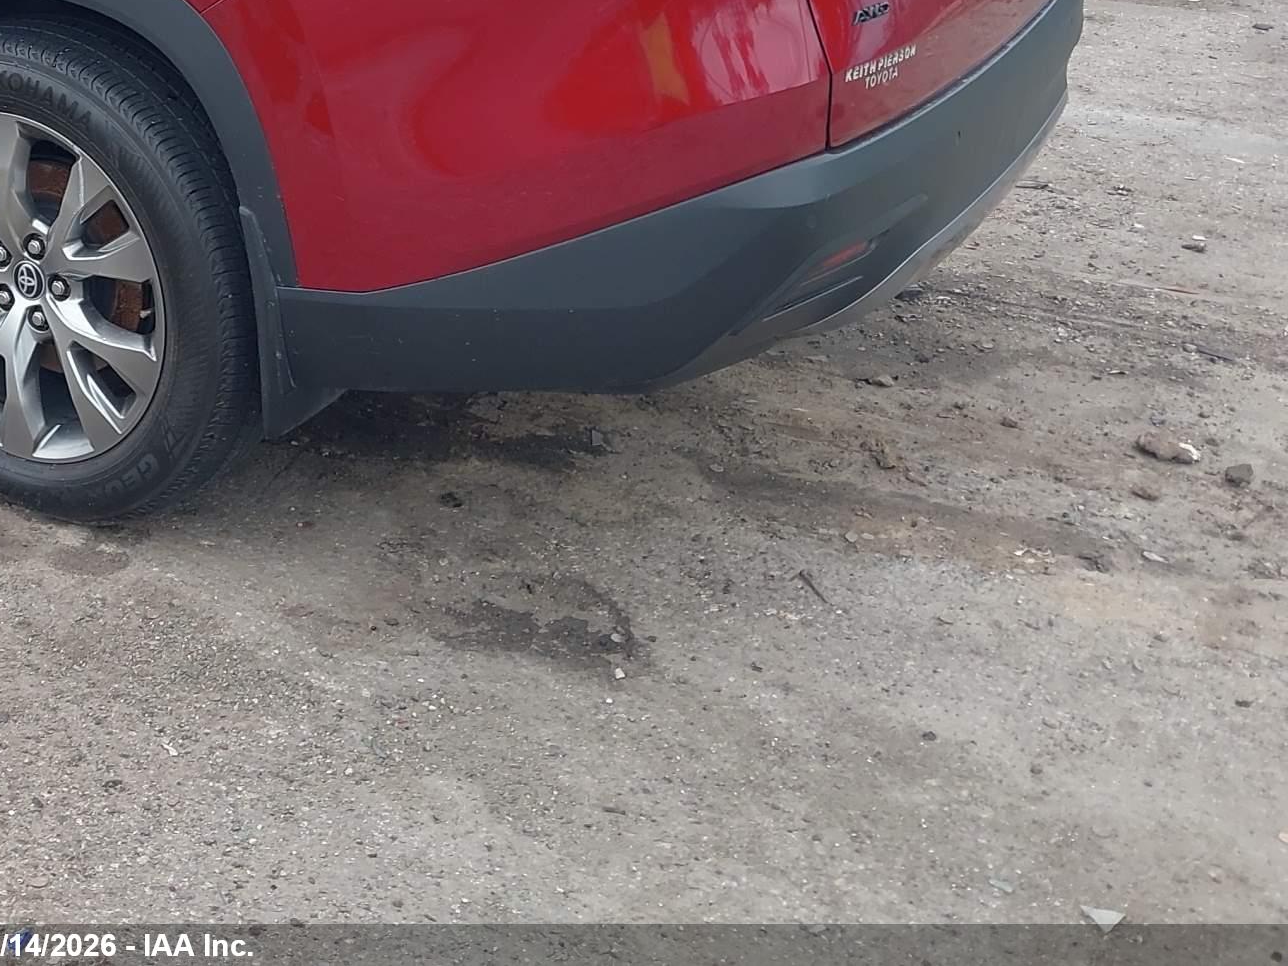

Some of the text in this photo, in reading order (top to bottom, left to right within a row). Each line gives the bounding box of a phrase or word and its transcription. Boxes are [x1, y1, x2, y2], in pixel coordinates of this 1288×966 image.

[852, 1, 890, 26] AWD
[844, 44, 917, 83] KEITH PIERSON
[864, 66, 899, 90] TOYOTA
